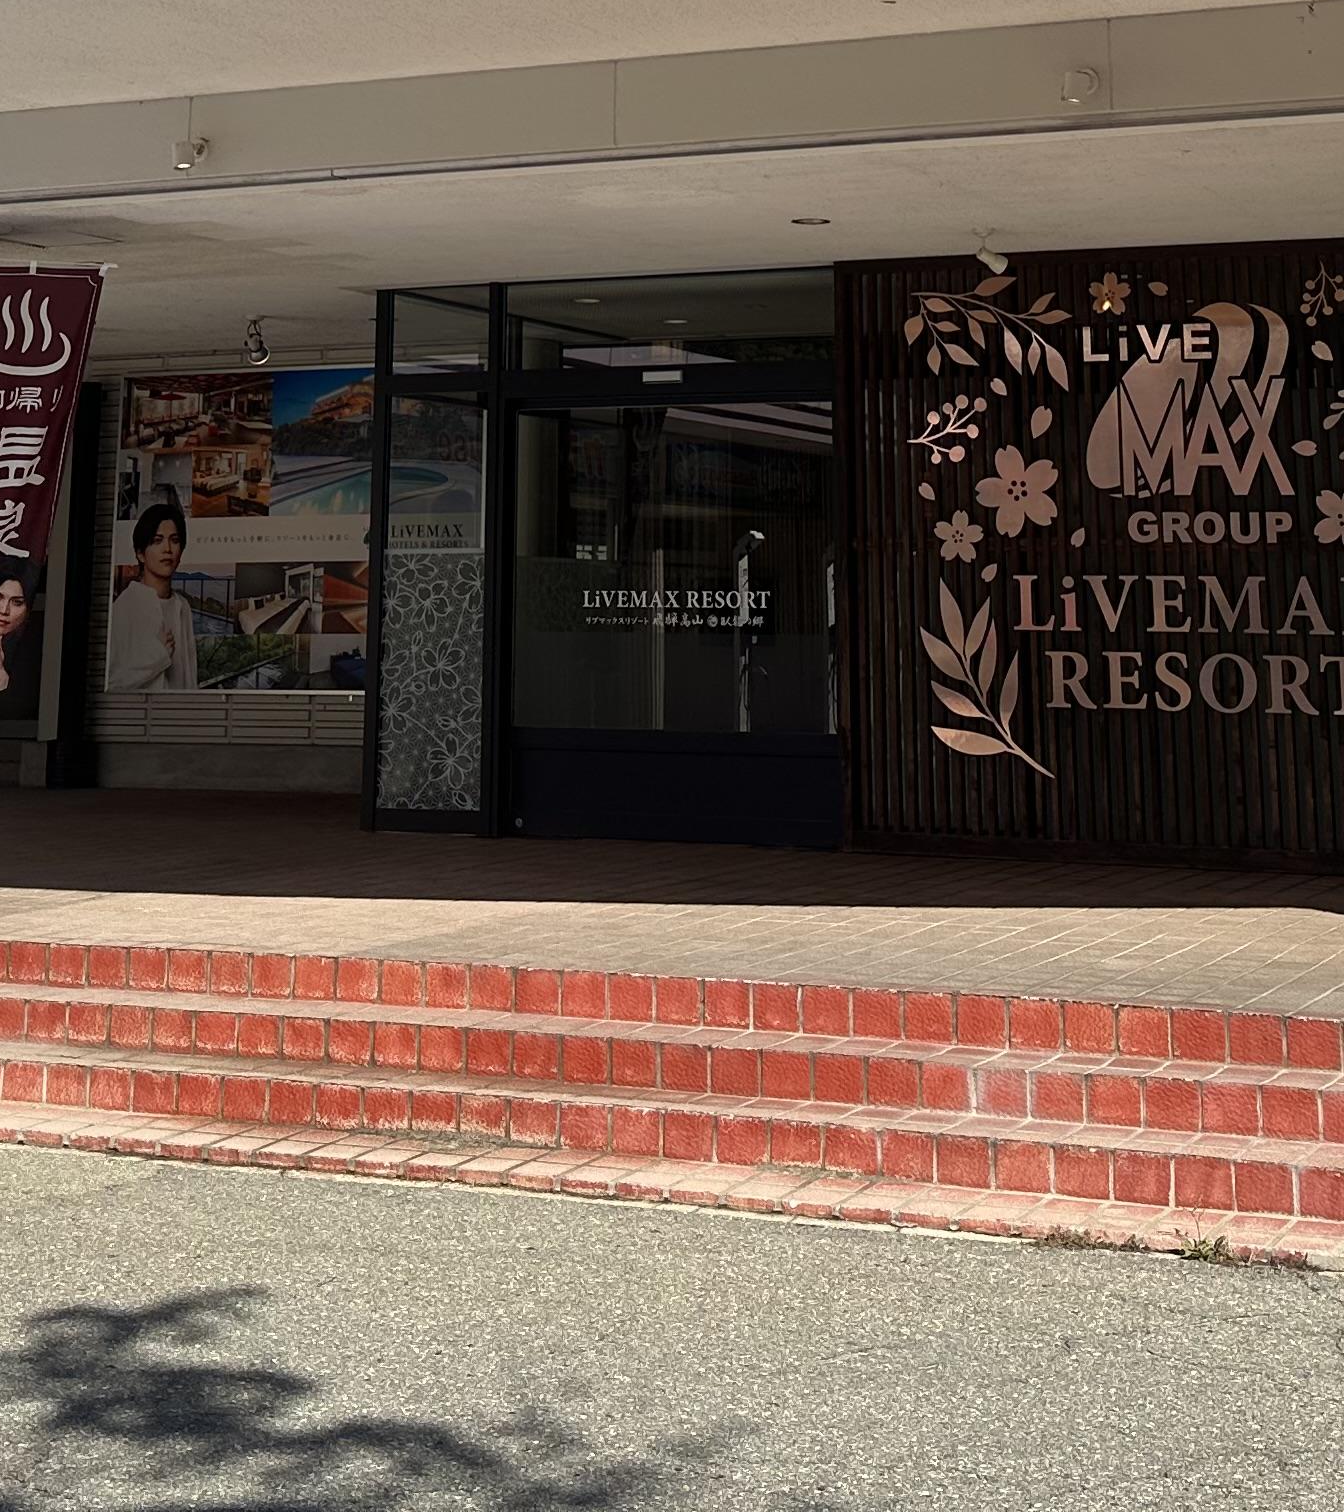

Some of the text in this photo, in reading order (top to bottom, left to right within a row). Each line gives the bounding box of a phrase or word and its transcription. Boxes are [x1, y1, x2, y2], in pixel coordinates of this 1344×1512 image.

[1082, 322, 1213, 363] LiVE
[1117, 377, 1295, 497] MAX
[391, 524, 463, 538] LiVEMAX
[1127, 511, 1293, 544] GROUP
[582, 590, 771, 609] LiVEMAX RESORT
